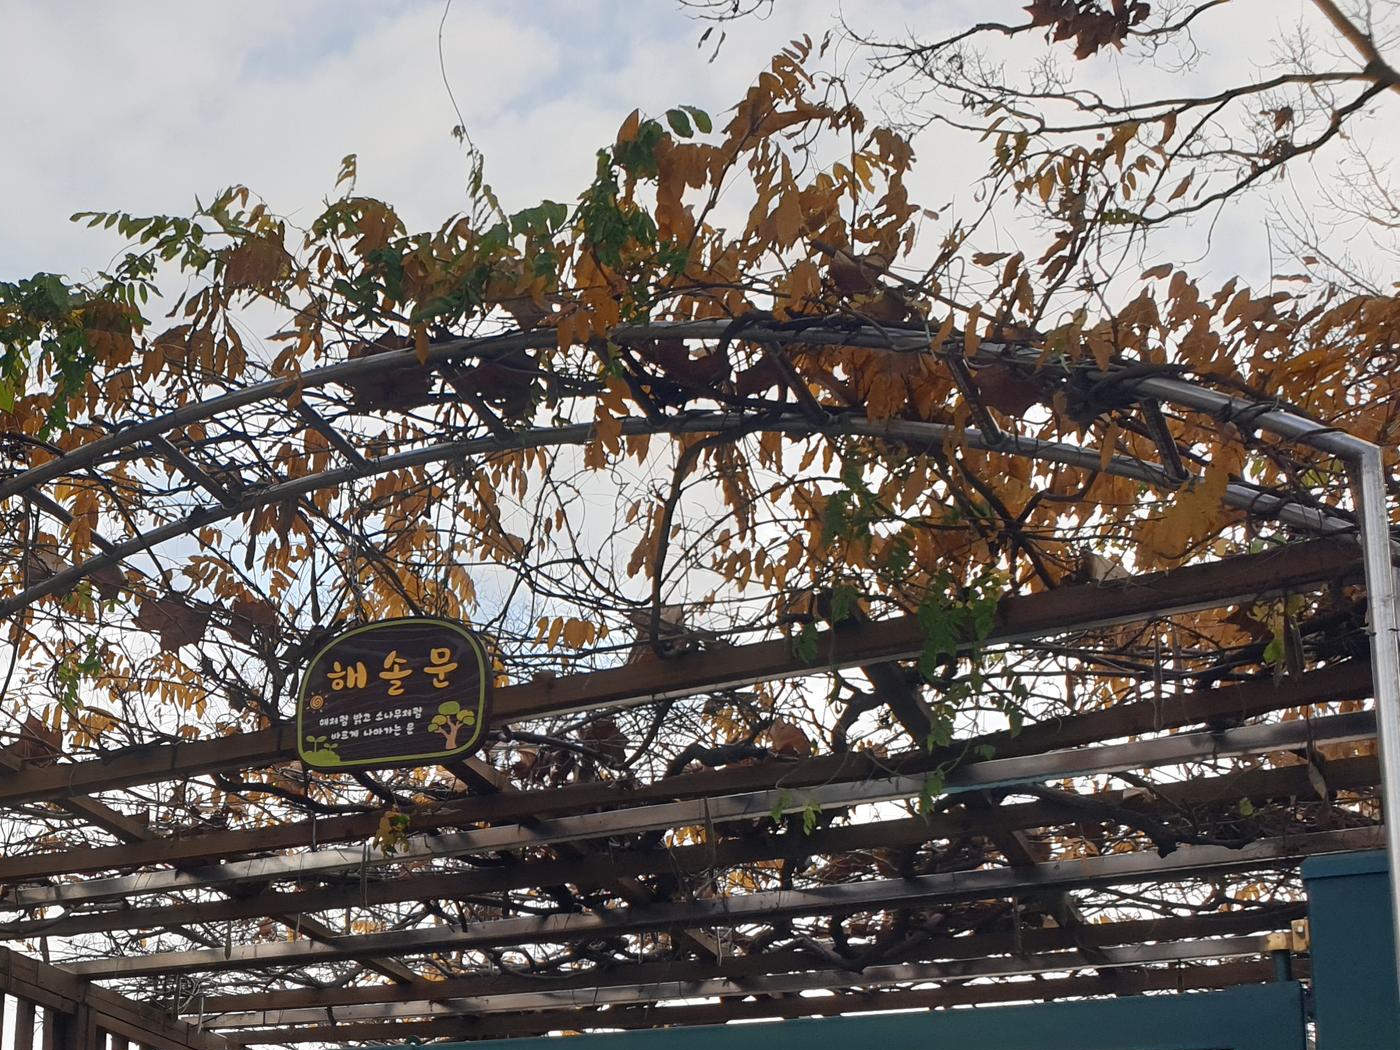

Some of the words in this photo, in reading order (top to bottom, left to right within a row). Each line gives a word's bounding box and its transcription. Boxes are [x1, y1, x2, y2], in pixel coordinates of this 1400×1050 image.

[327, 648, 457, 695] 해솔문
[353, 713, 371, 725] 밝고
[375, 706, 423, 721] 소나무처럼
[331, 729, 359, 740] 바르게
[363, 724, 401, 737] 나아가는
[406, 722, 415, 735] 문
